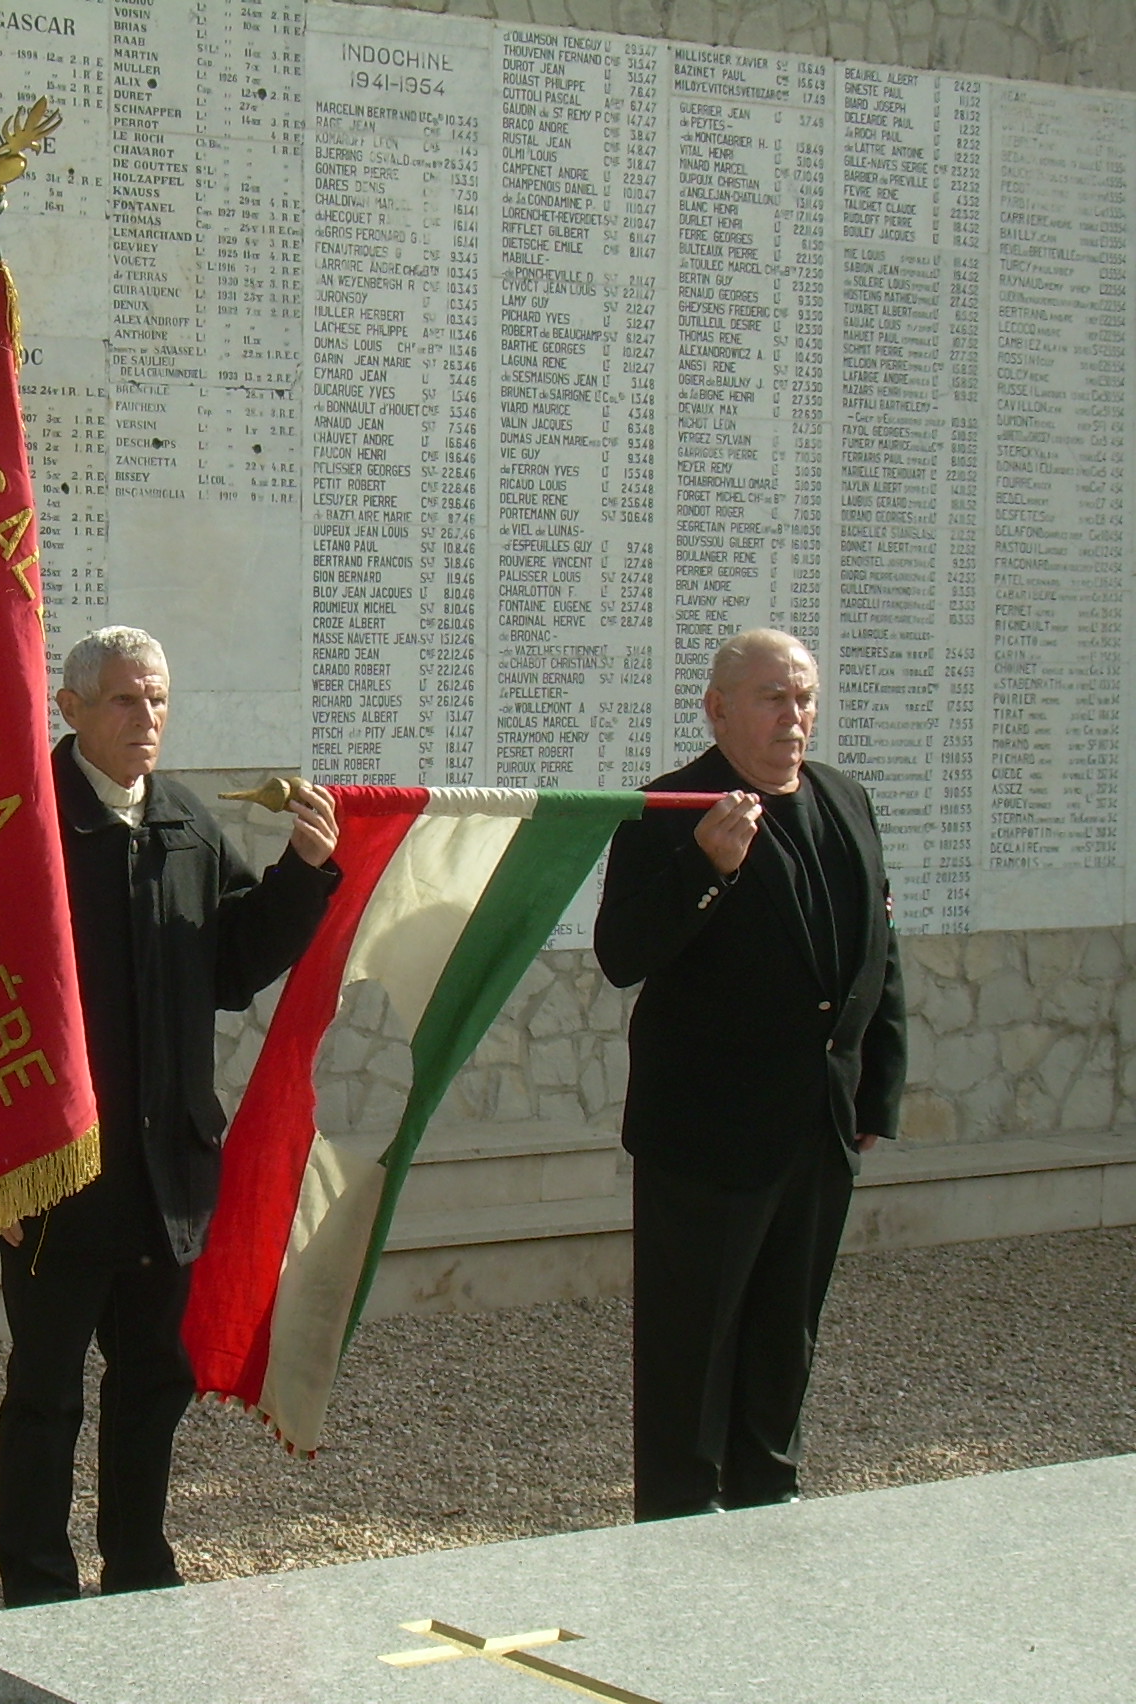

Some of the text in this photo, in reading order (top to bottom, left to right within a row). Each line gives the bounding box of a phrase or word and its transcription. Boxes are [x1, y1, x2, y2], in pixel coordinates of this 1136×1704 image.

[114, 7, 151, 20] VOISIN
[114, 21, 147, 33] BRIAS
[114, 35, 145, 47] RAAB
[114, 48, 158, 62] MARTIN
[342, 43, 454, 72] INDOCHINE
[114, 62, 161, 76] MULLER
[503, 59, 565, 75] DUROT JEAN
[674, 63, 746, 82] BAZINET PAUL
[114, 76, 141, 88] ALIX
[350, 71, 445, 97] 1941-1954
[114, 89, 152, 102] DURET
[503, 88, 582, 106] CUTTOLI PASCAL
[113, 103, 182, 119] SCHNAPPER
[315, 100, 417, 122] MARCELIN BERTRAND
[113, 117, 159, 130] PERROT
[502, 132, 572, 149] RUSTAL JEAN
[113, 144, 174, 159] CHAVAROT
[502, 162, 589, 181] CAMPENET ANDRE
[113, 172, 185, 187] HOLZAPFEL
[113, 185, 160, 198] KNAUSS
[113, 200, 175, 213] FONTANEL
[113, 214, 162, 226] THOMAS
[113, 227, 192, 242] LEMARCHAND
[502, 222, 590, 239] RIFFLET GILBERT
[113, 242, 158, 254] GEVREY
[501, 309, 570, 325] PICHARD YVES
[501, 354, 568, 370] LAGUNA RENE
[314, 384, 396, 400] DUCARUGE YVES
[501, 402, 571, 416] VIARD MAURICE
[678, 402, 738, 416] DEVAUX MAX
[115, 456, 177, 468] ZANCHETTA
[115, 471, 149, 483] BISSEY
[313, 479, 387, 491] PETIT ROBERT
[500, 508, 580, 521] PORTEMANN GUY
[313, 524, 409, 538] DUPEUX JEAN LOUIS
[313, 555, 413, 569] BERTRAND FRANCOIS
[313, 571, 382, 584] GION BERNARD
[675, 565, 759, 578] PERRIER GEORGES
[313, 586, 413, 600] BLOY JEAN JACQUES
[312, 602, 397, 614] ROUMIEUX MICHEL
[498, 599, 592, 613] FONTAINE EUGENE
[312, 617, 385, 630] CROZE ALBERT
[498, 614, 586, 627] CARDINAL HERVE
[312, 648, 380, 660] RENARD JEAN
[311, 680, 392, 692] WEBER CHARLES
[497, 716, 580, 728] NICOLAS MARCEL
[311, 743, 382, 755] MEREL PIERRE
[311, 758, 381, 770] DELIN ROBERT
